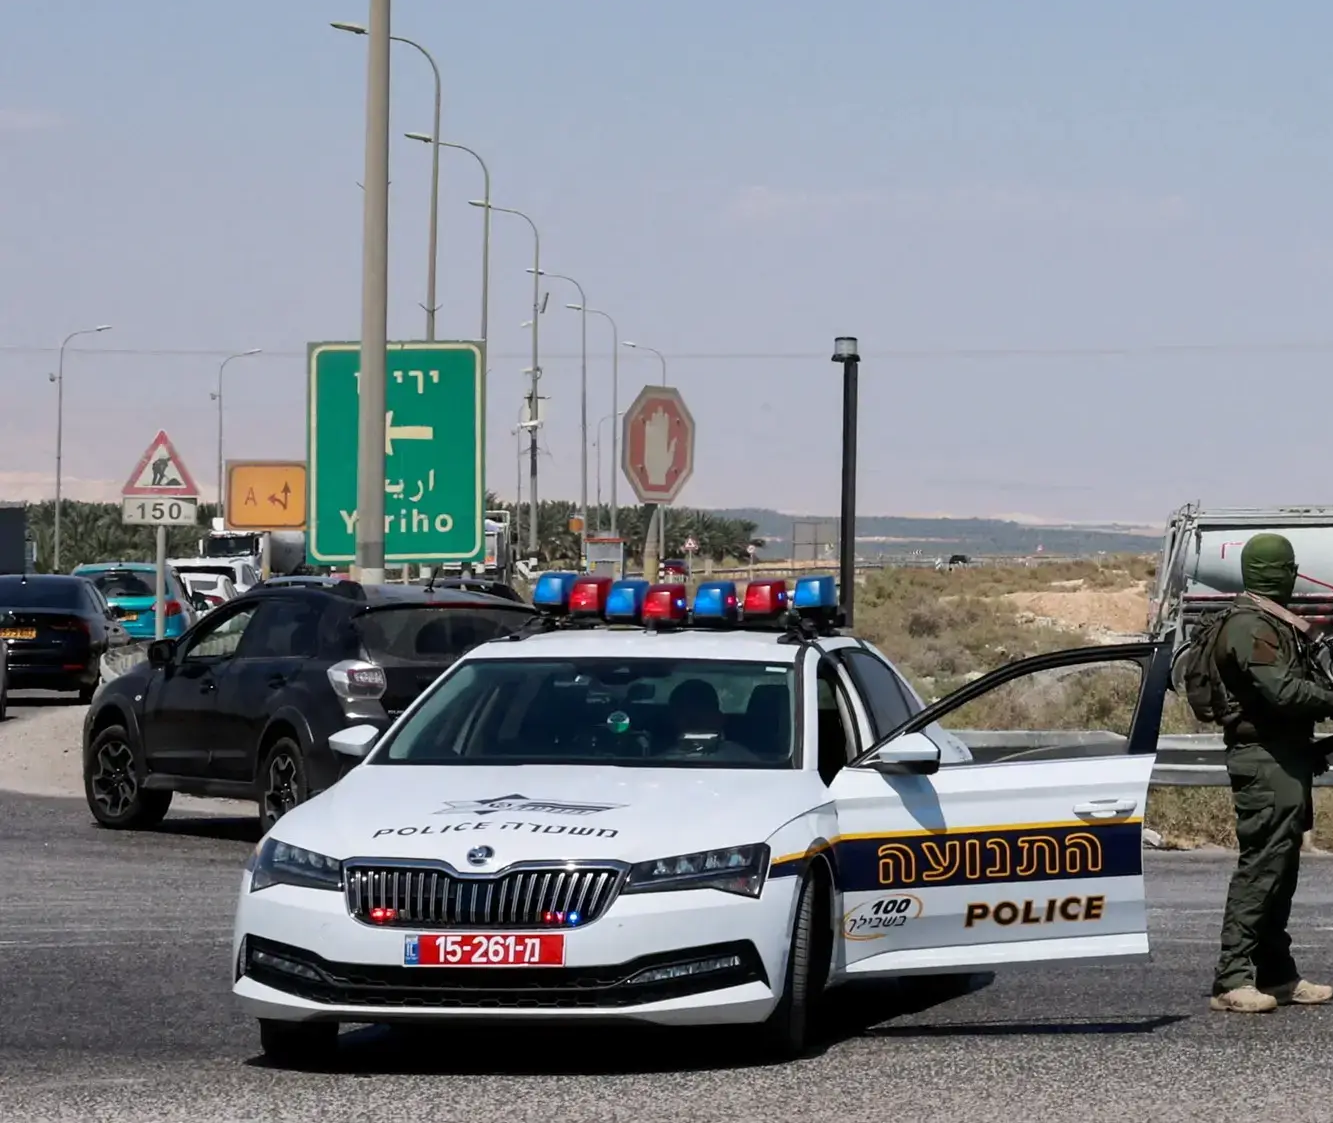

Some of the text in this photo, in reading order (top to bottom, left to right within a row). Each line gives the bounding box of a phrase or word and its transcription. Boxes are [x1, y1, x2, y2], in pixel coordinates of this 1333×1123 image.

[244, 487, 258, 507] A
[136, 502, 182, 520] 150
[340, 509, 454, 534] Yriho
[372, 821, 493, 838] POLICE
[500, 821, 620, 839] משטרה
[877, 832, 1103, 885] התנועה
[872, 898, 912, 915] 100
[964, 895, 1106, 928] POLICE
[849, 914, 907, 932] בשבילך
